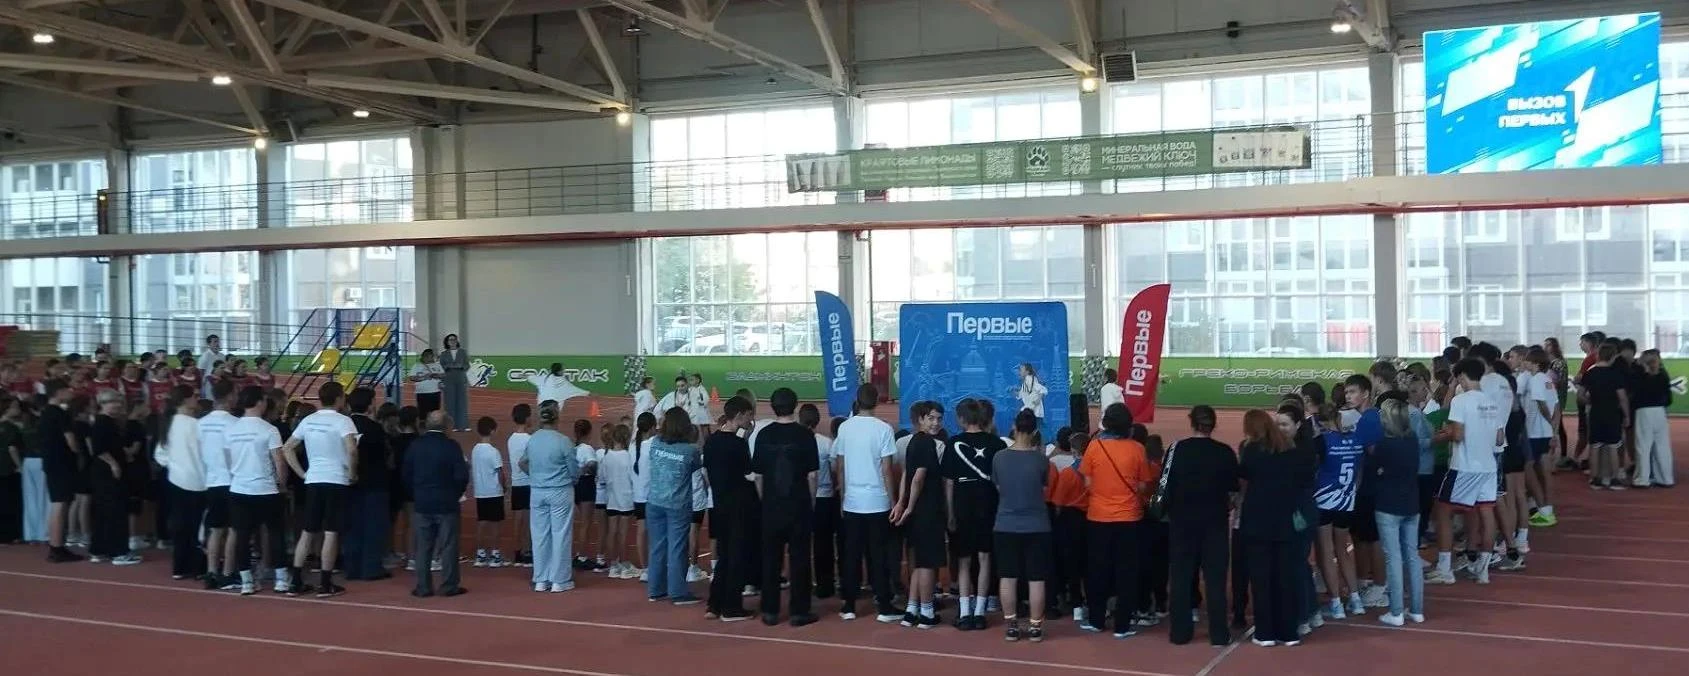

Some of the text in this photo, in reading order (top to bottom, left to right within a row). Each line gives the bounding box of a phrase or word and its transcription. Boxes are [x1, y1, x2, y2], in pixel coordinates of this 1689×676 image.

[1507, 94, 1567, 111] ВЫЗОВ
[1498, 111, 1567, 128] ПЕРВЫХ
[1101, 141, 1196, 154] МИНЕРАЛЬНАЯ ВОДА
[1101, 150, 1197, 164] МЕДВЕЖИЙ КЛЮЧ
[946, 311, 1033, 341] Первые
[828, 312, 850, 392] Первые
[1124, 309, 1153, 396] Первые
[1339, 462, 1355, 486] 5
